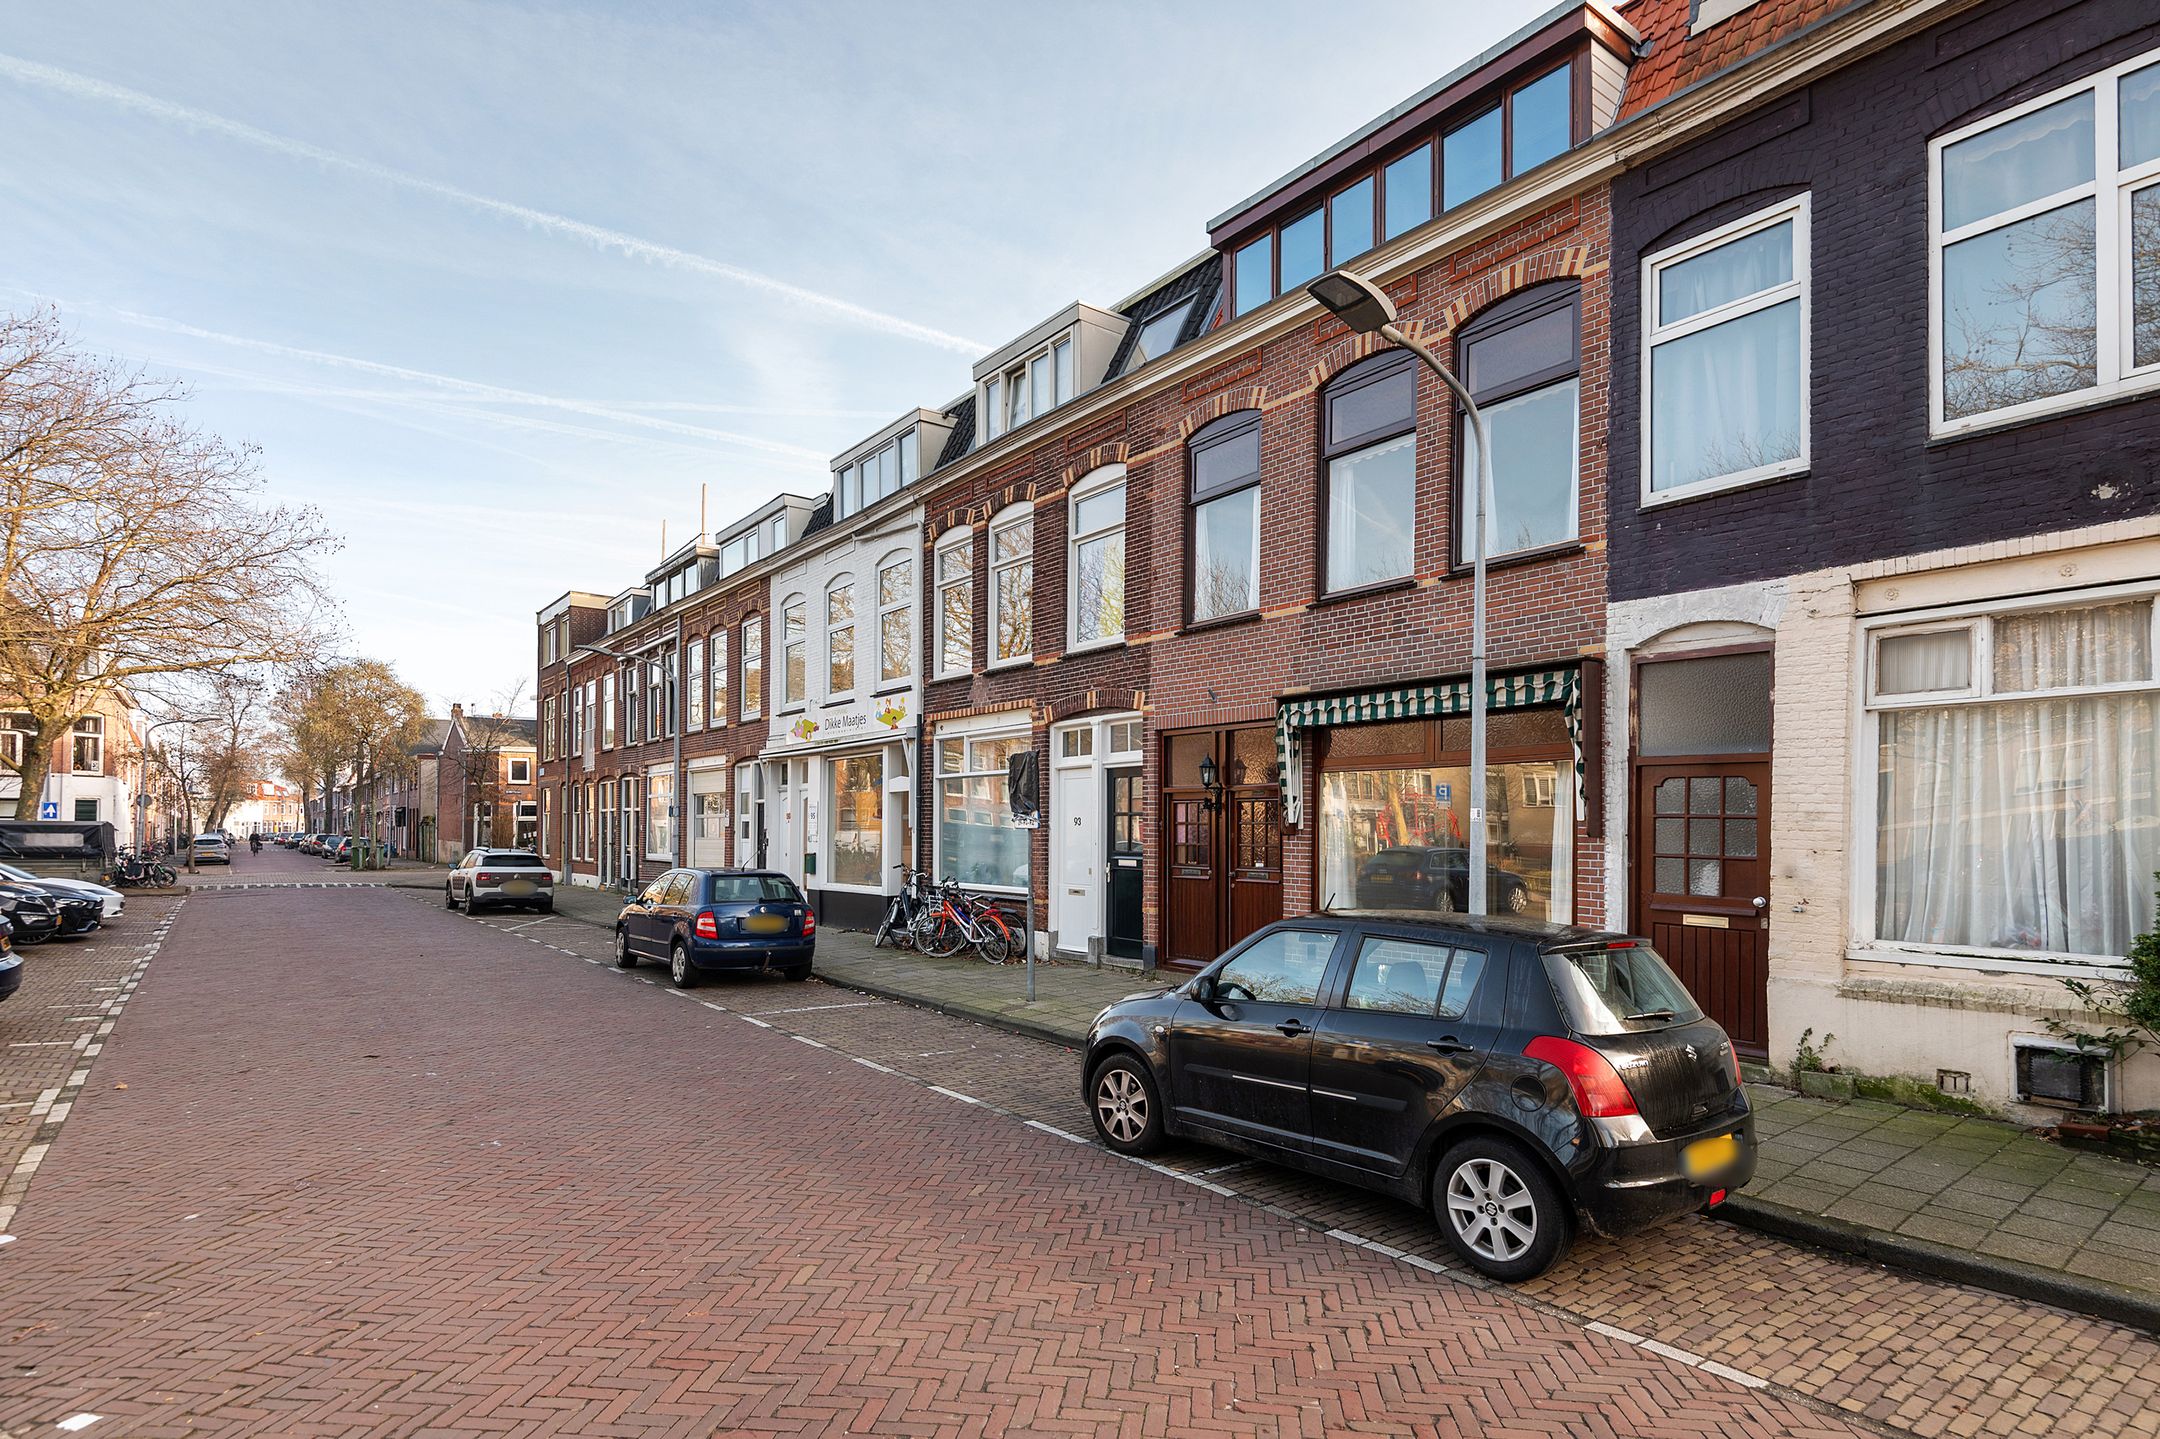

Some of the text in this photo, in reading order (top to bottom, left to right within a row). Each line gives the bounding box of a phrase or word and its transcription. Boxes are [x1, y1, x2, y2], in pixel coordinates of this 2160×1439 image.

[825, 713, 867, 730] Dikke Maatjes
[1073, 817, 1082, 826] 93
